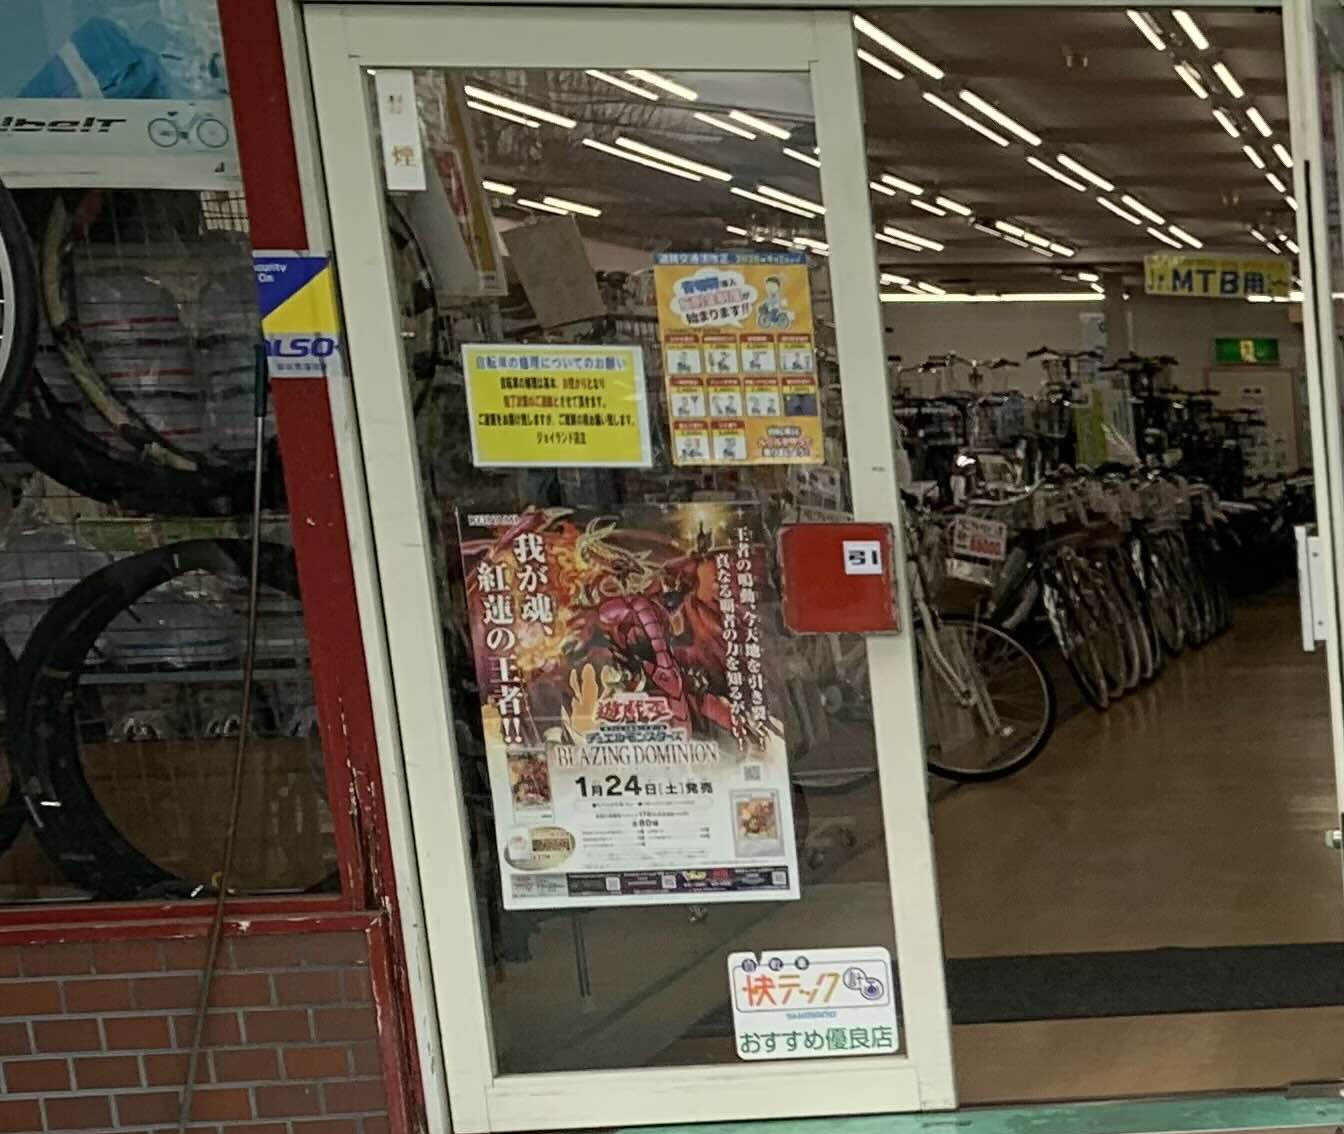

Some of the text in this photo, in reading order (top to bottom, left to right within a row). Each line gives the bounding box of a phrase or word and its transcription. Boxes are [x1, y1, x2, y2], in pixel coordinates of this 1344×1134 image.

[557, 742, 719, 768] BLAZING DOMINION
[742, 972, 841, 1008] 快テック
[739, 1025, 893, 1054] おすすめ優良店
